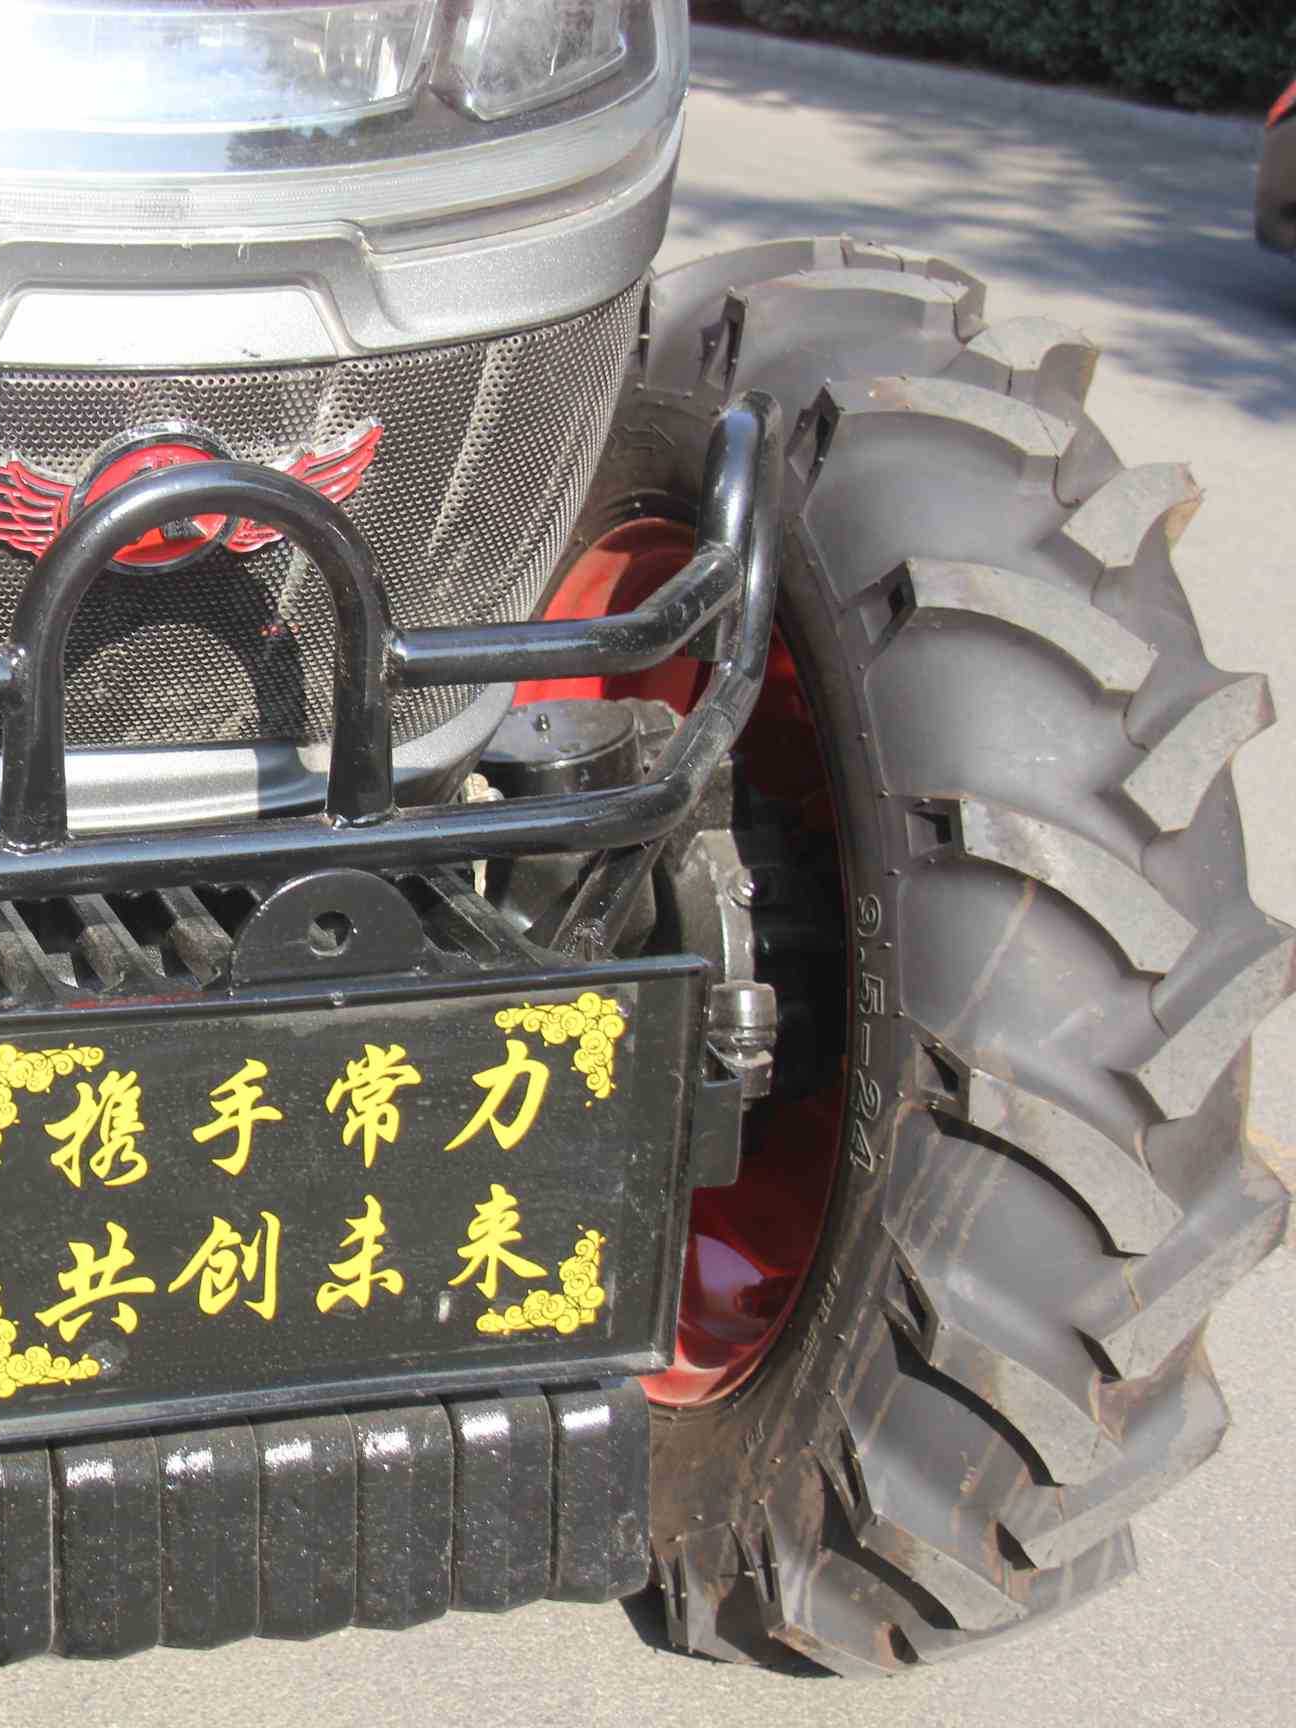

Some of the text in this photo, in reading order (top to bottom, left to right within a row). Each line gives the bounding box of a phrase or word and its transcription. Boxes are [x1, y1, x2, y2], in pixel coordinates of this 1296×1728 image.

[850, 894, 885, 1172] 9.5-24
[44, 1040, 550, 1187] 携手常力
[35, 1183, 548, 1343] 共创未来
